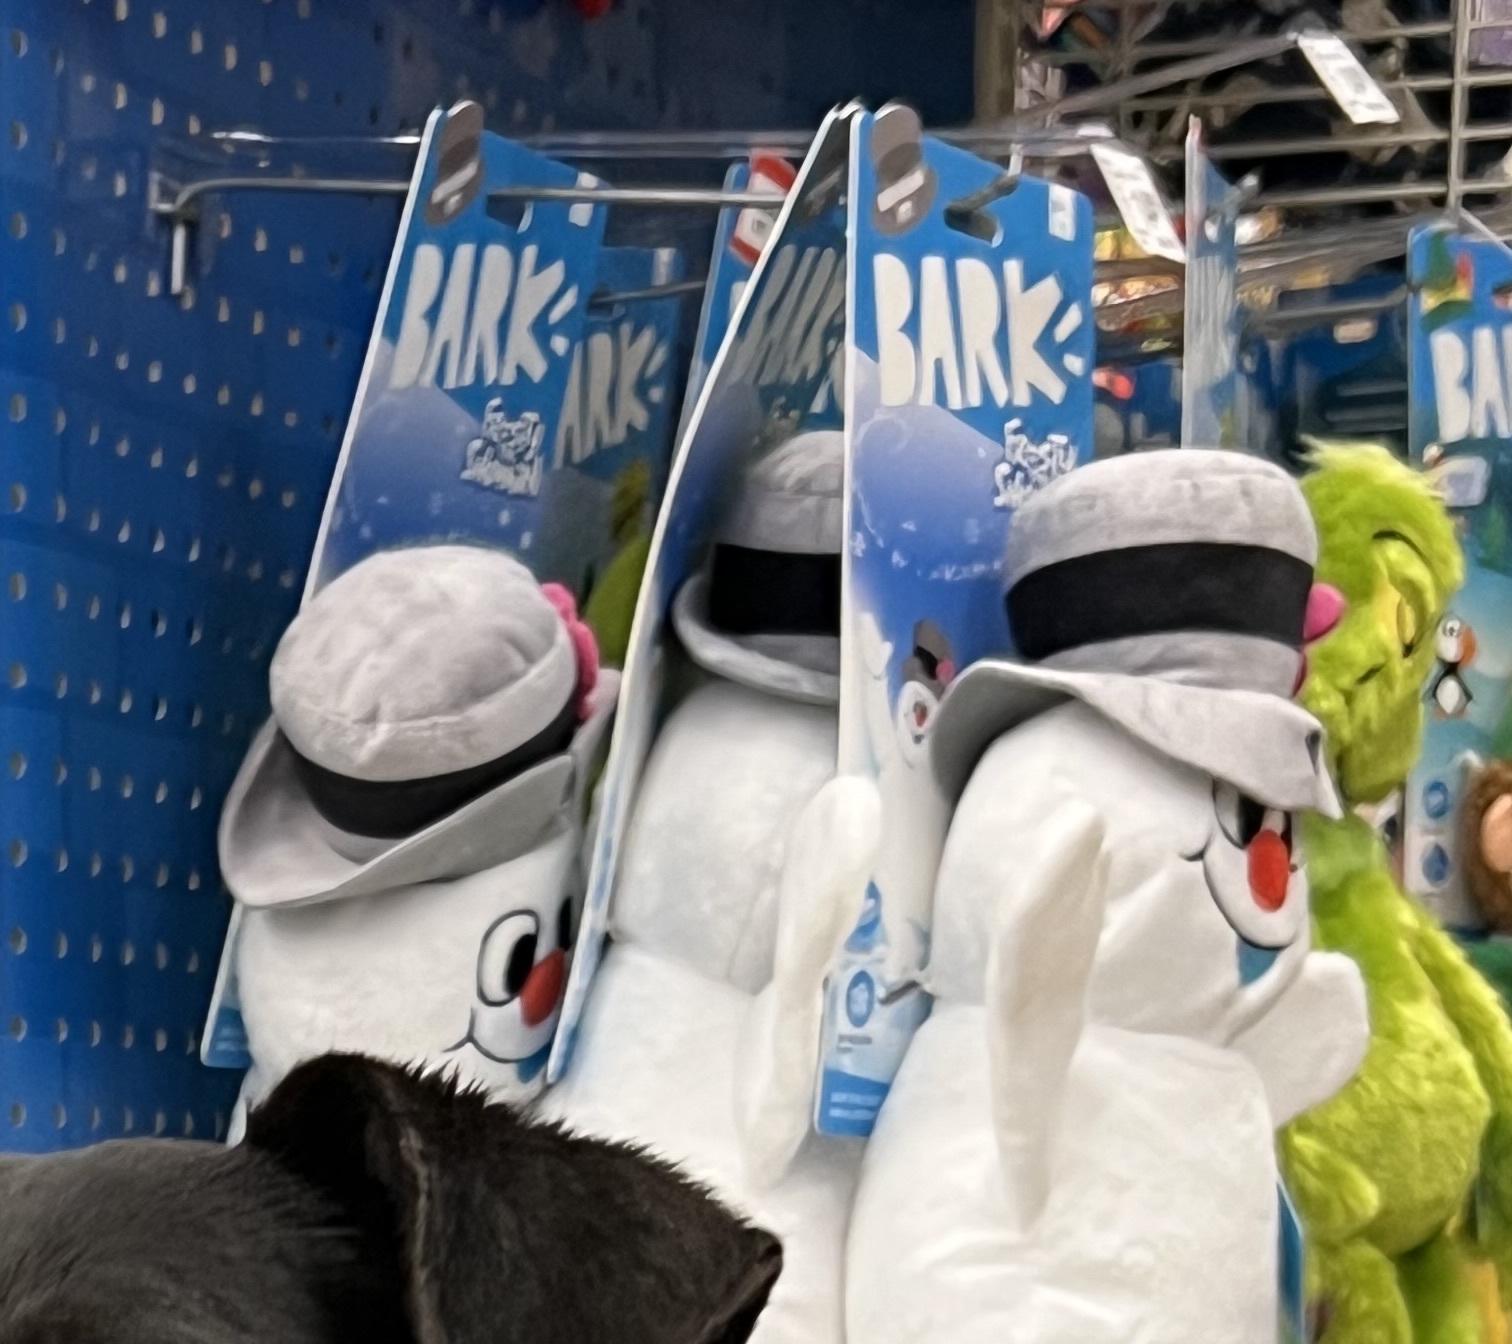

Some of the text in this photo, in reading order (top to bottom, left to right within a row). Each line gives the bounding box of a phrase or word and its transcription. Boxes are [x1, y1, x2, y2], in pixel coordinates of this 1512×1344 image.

[390, 244, 566, 390] BARK
[873, 253, 1068, 410] BARK
[1430, 324, 1512, 444] BA
[553, 321, 656, 470] ARK
